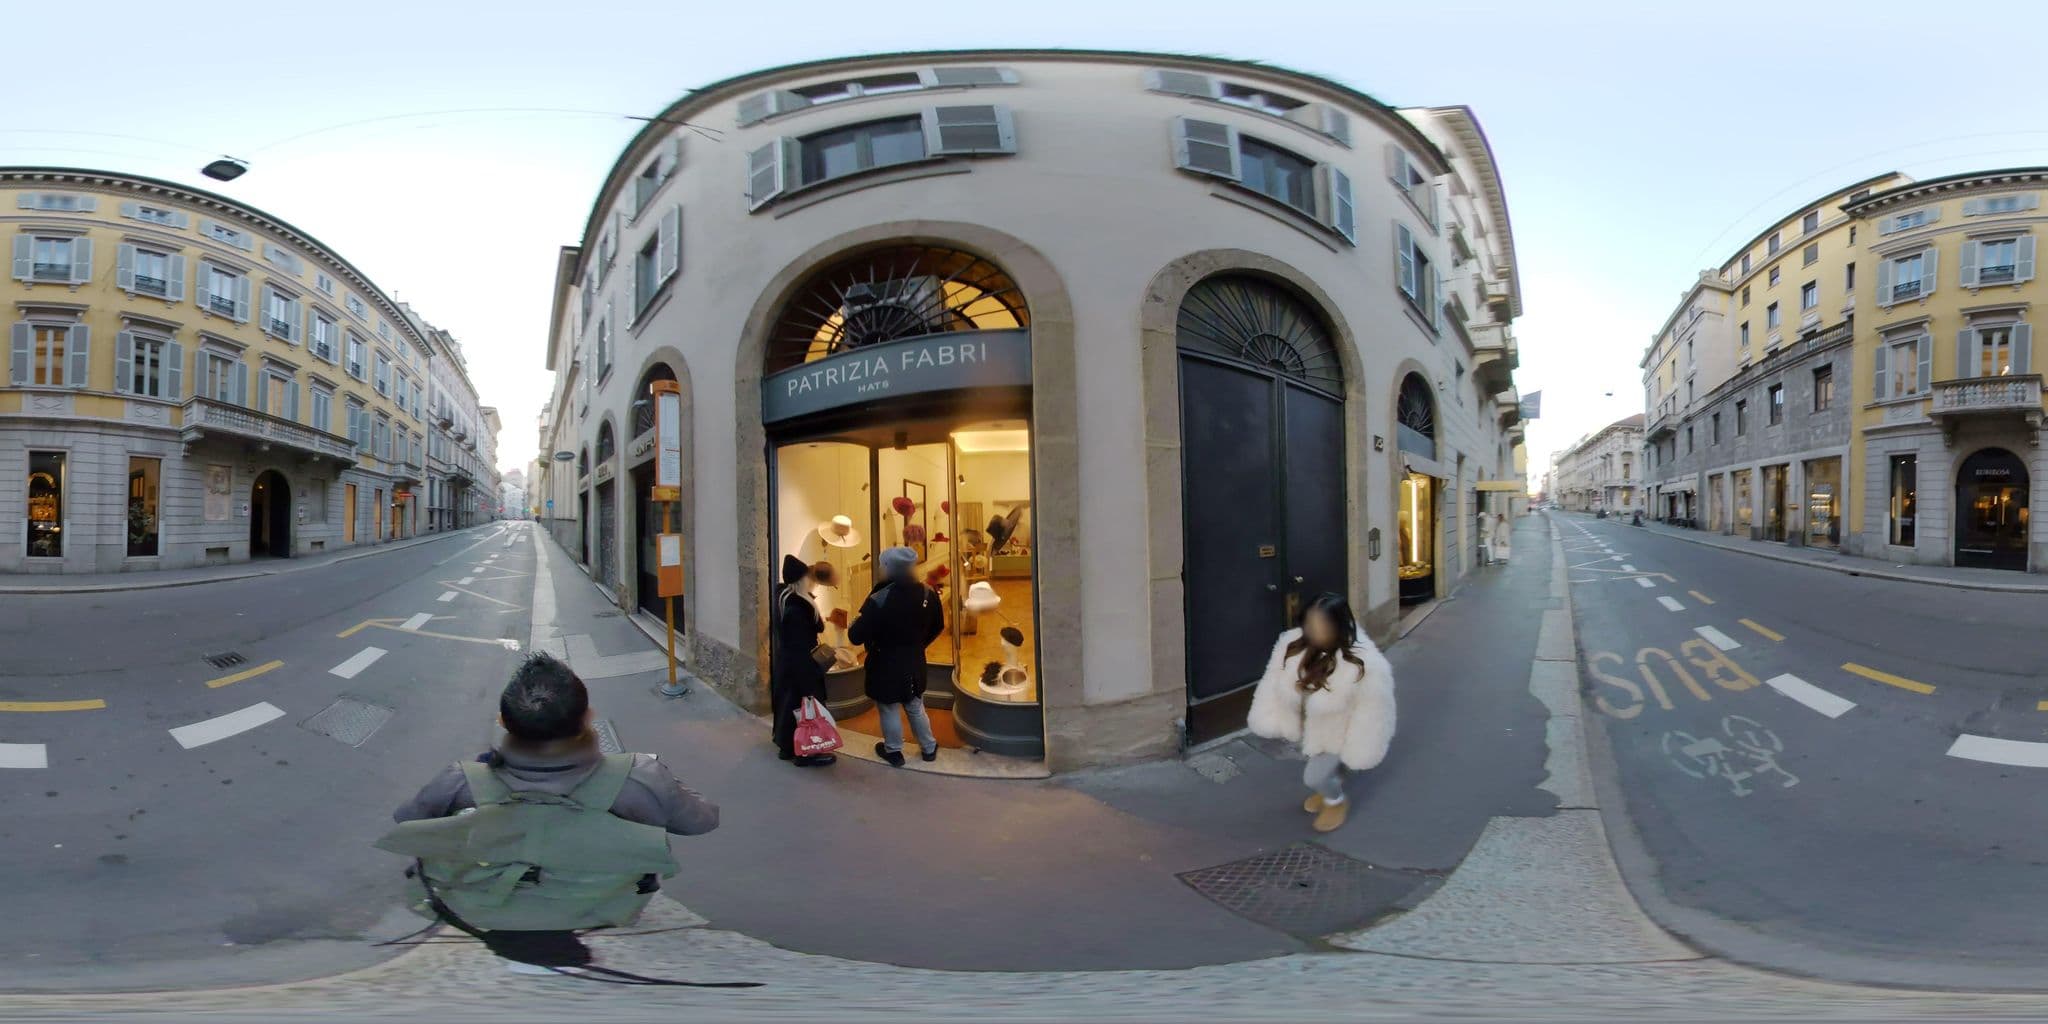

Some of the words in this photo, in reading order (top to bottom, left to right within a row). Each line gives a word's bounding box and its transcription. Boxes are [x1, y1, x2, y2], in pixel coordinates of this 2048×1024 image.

[787, 356, 889, 398] PATRIZIA
[901, 343, 987, 371] FABRI
[857, 381, 890, 393] HATS
[1587, 638, 1761, 720] BUS
